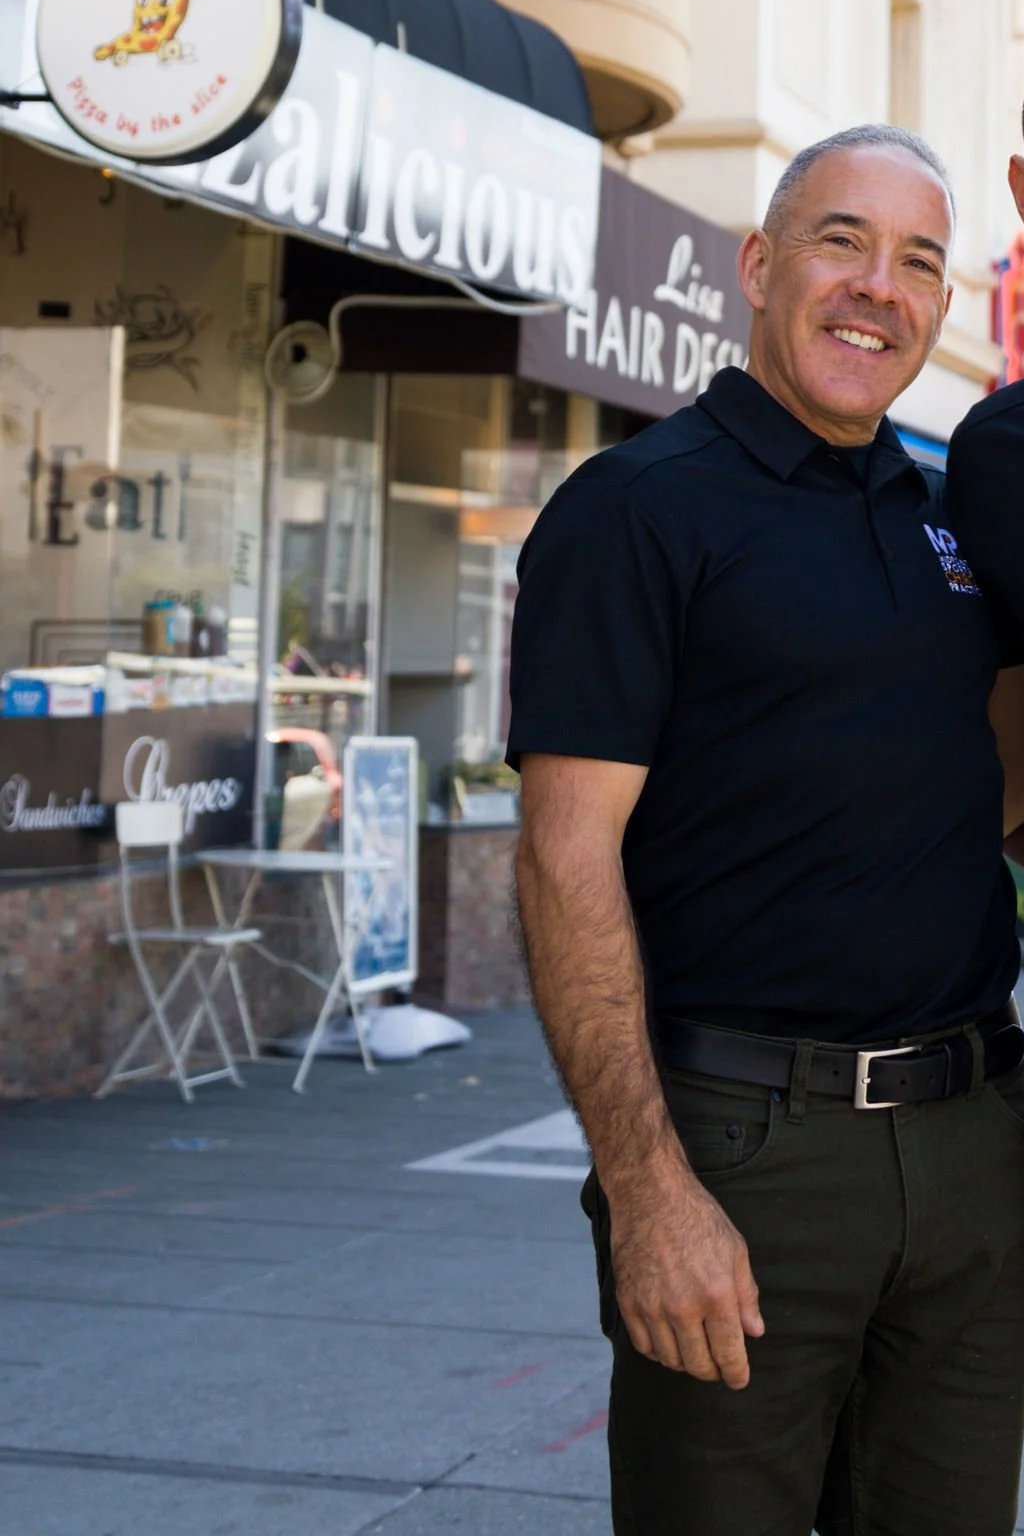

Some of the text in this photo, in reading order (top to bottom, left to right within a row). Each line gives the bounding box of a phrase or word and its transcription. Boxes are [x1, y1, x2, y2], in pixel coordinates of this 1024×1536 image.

[66, 74, 228, 138] Pizza by the slice
[566, 289, 665, 388] HAIR
